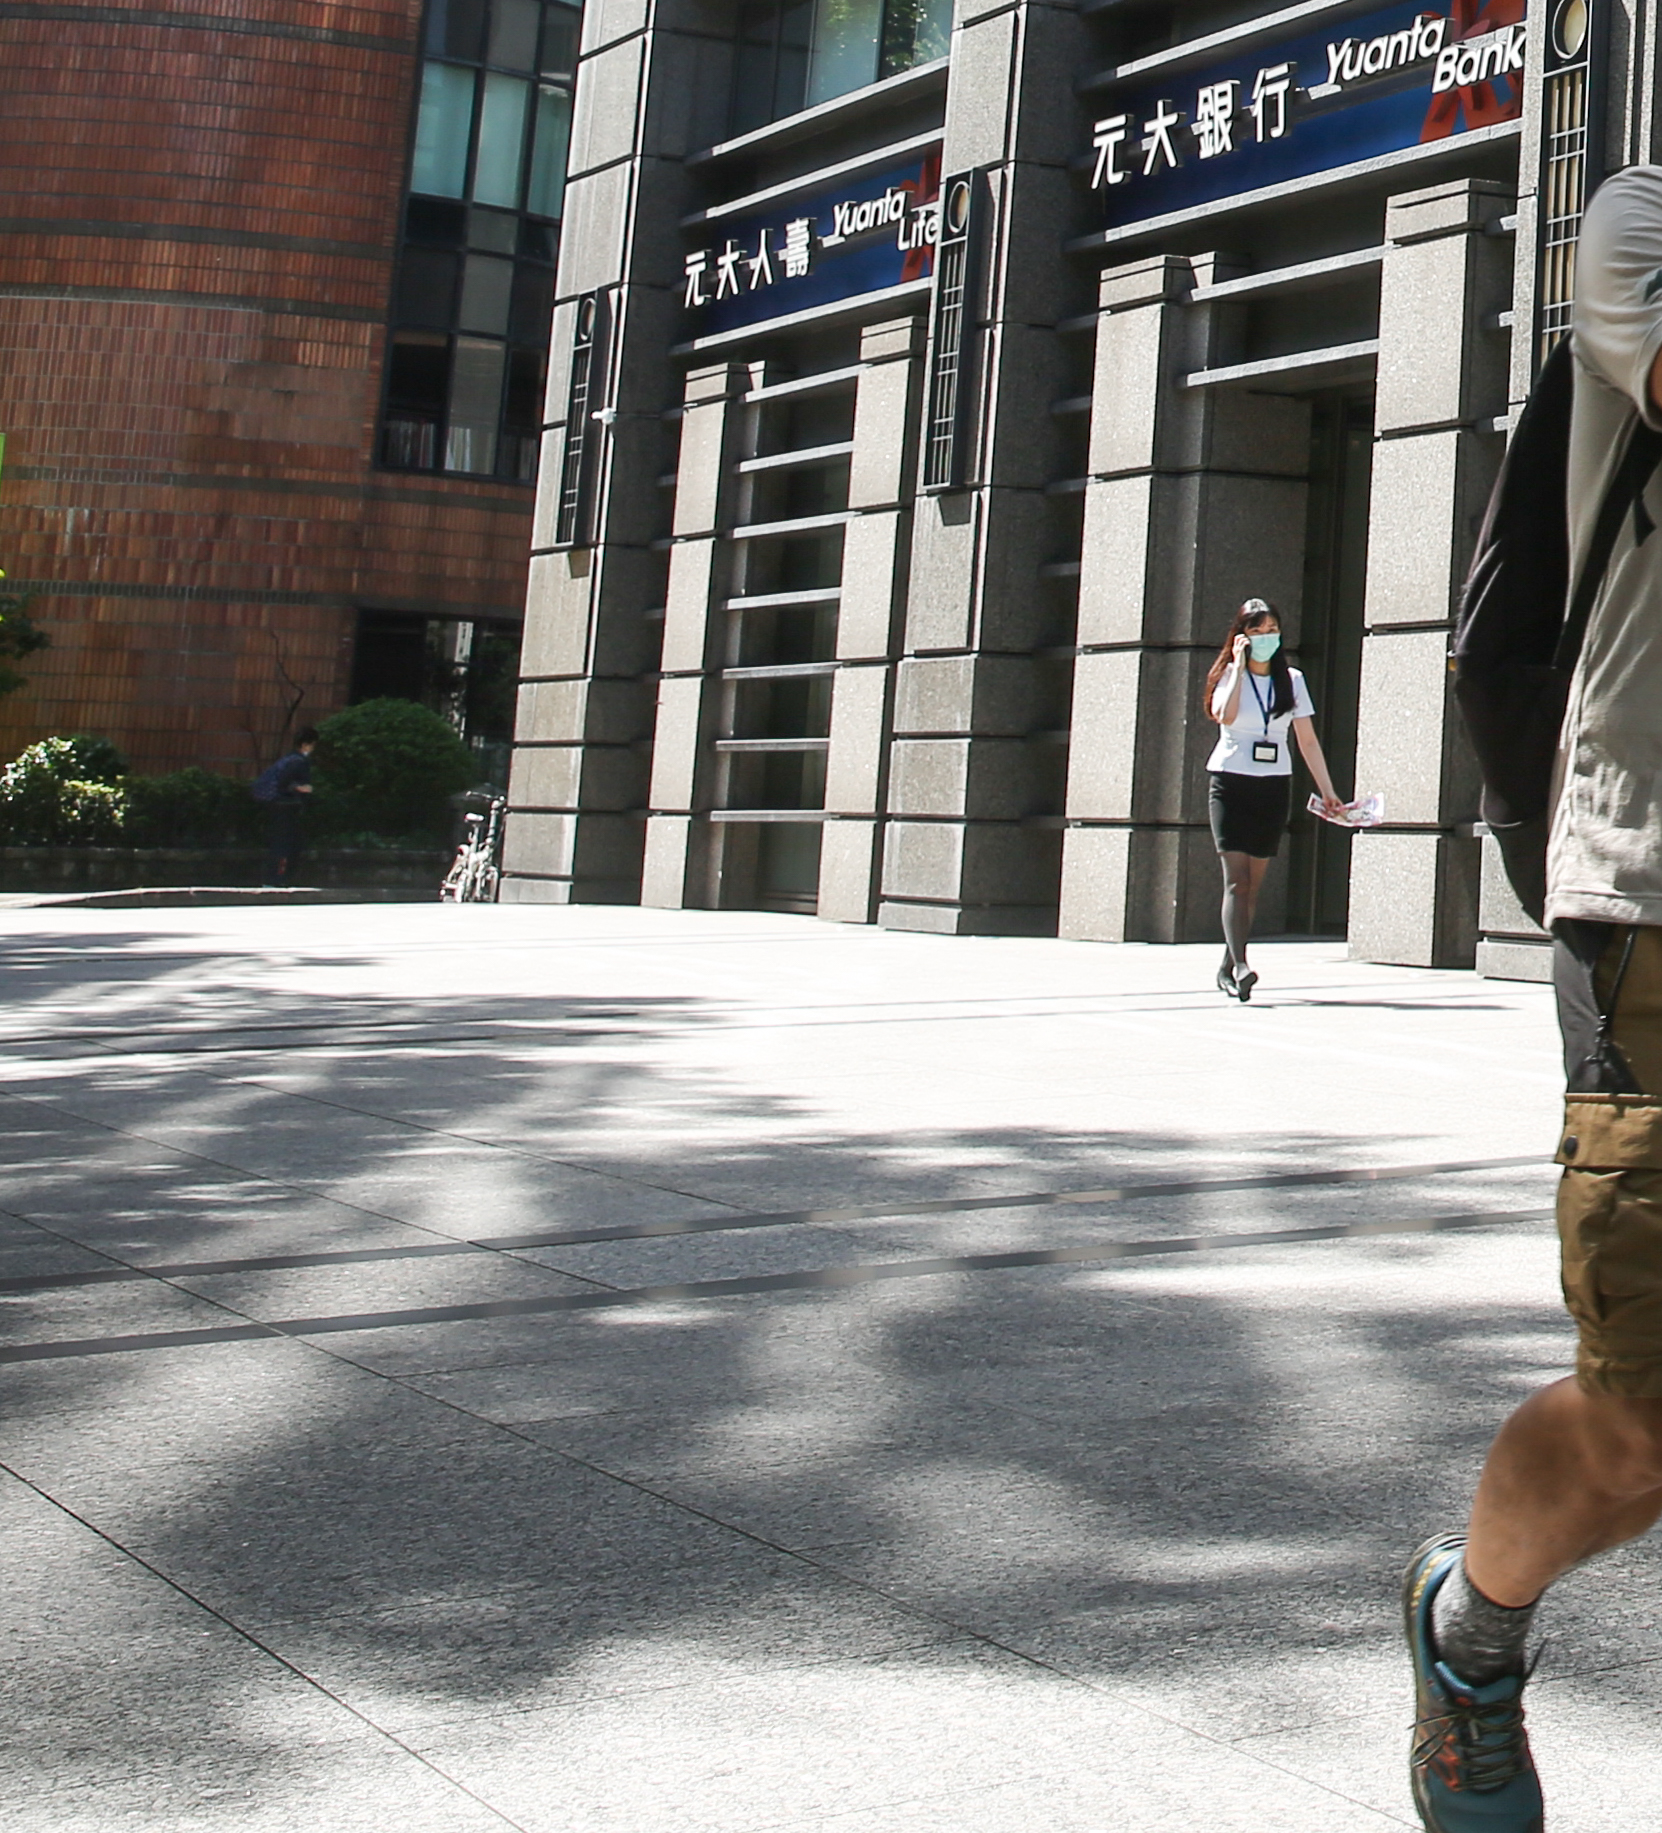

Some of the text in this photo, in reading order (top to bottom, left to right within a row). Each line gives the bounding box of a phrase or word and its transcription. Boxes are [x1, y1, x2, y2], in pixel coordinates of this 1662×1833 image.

[1327, 15, 1447, 83] Yuanta
[1432, 26, 1526, 92] Bank
[1091, 61, 1296, 189] 元大銀行
[831, 187, 907, 238] Yuanta
[897, 210, 940, 251] Life
[684, 217, 812, 308] 元大人壽
